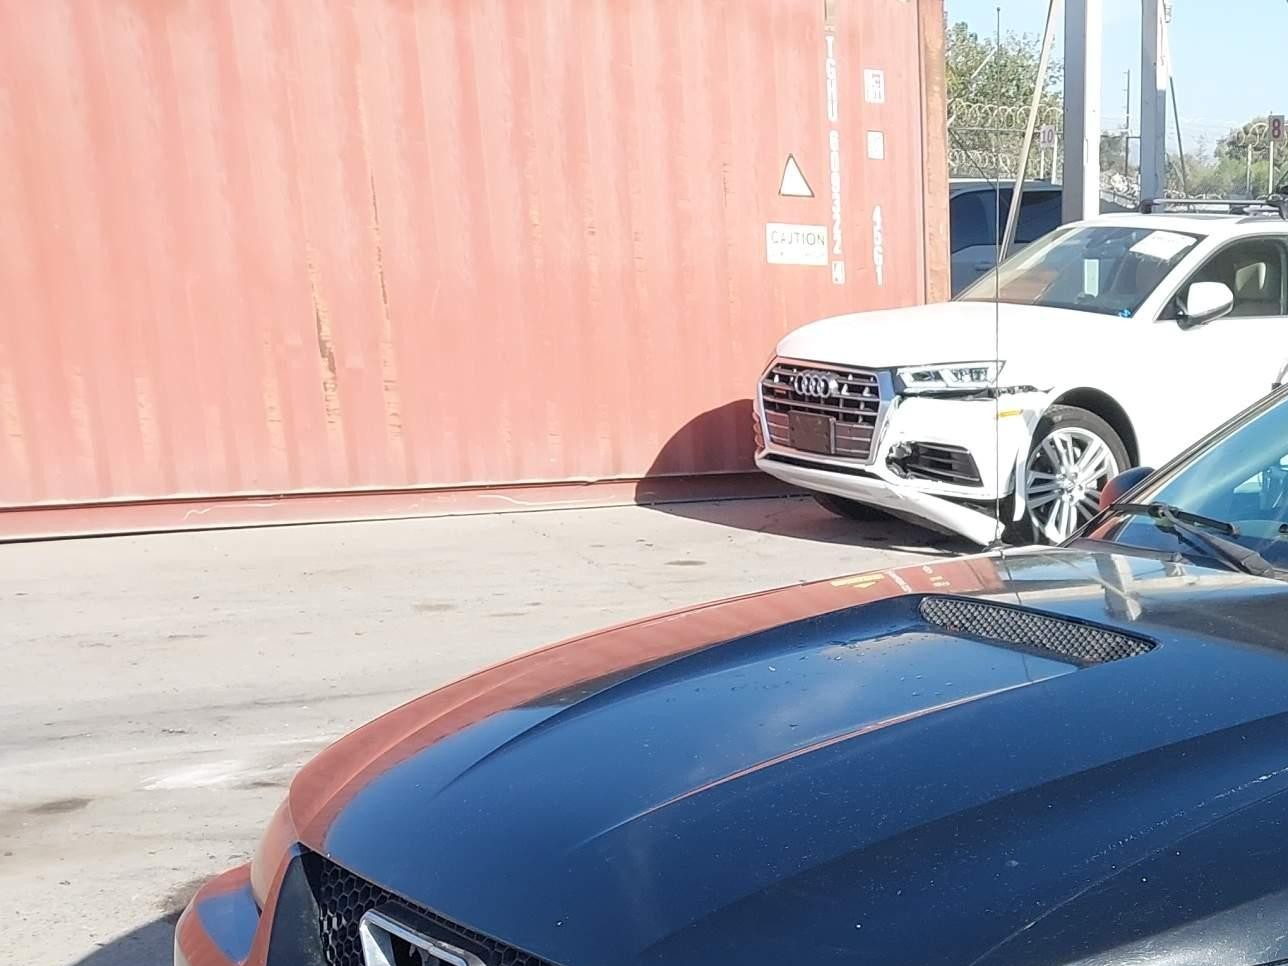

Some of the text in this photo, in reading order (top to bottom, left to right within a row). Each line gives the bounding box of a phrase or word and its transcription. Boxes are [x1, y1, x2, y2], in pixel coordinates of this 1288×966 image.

[1041, 128, 1054, 144] 10
[1272, 118, 1281, 138] 8
[771, 230, 825, 246] CAUTION
